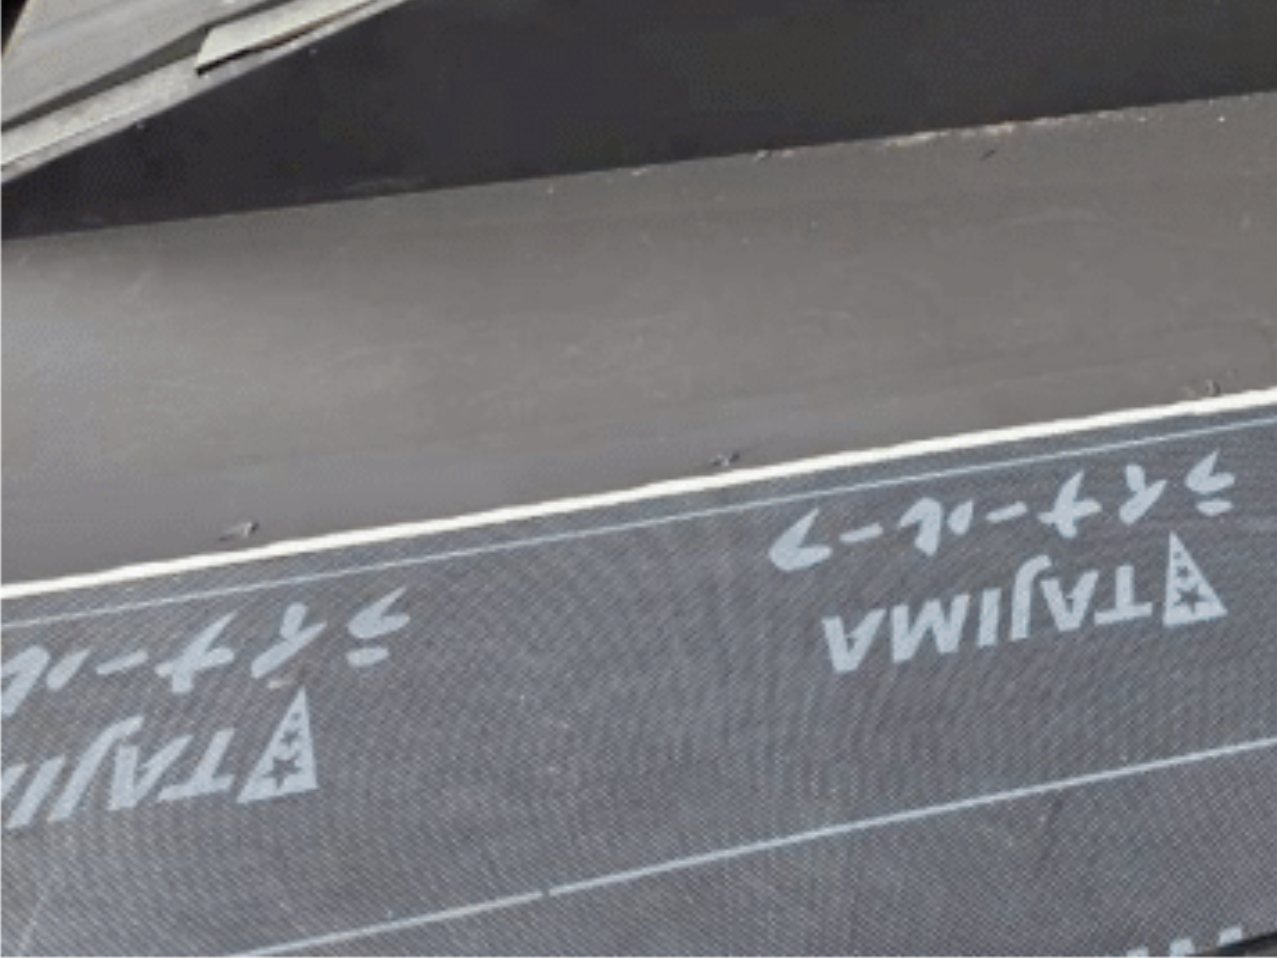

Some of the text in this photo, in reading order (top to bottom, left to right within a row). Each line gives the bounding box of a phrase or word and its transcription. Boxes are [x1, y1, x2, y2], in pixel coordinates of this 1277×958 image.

[767, 450, 1236, 573] ライナールーフ
[821, 554, 1154, 675] TAJIMA
